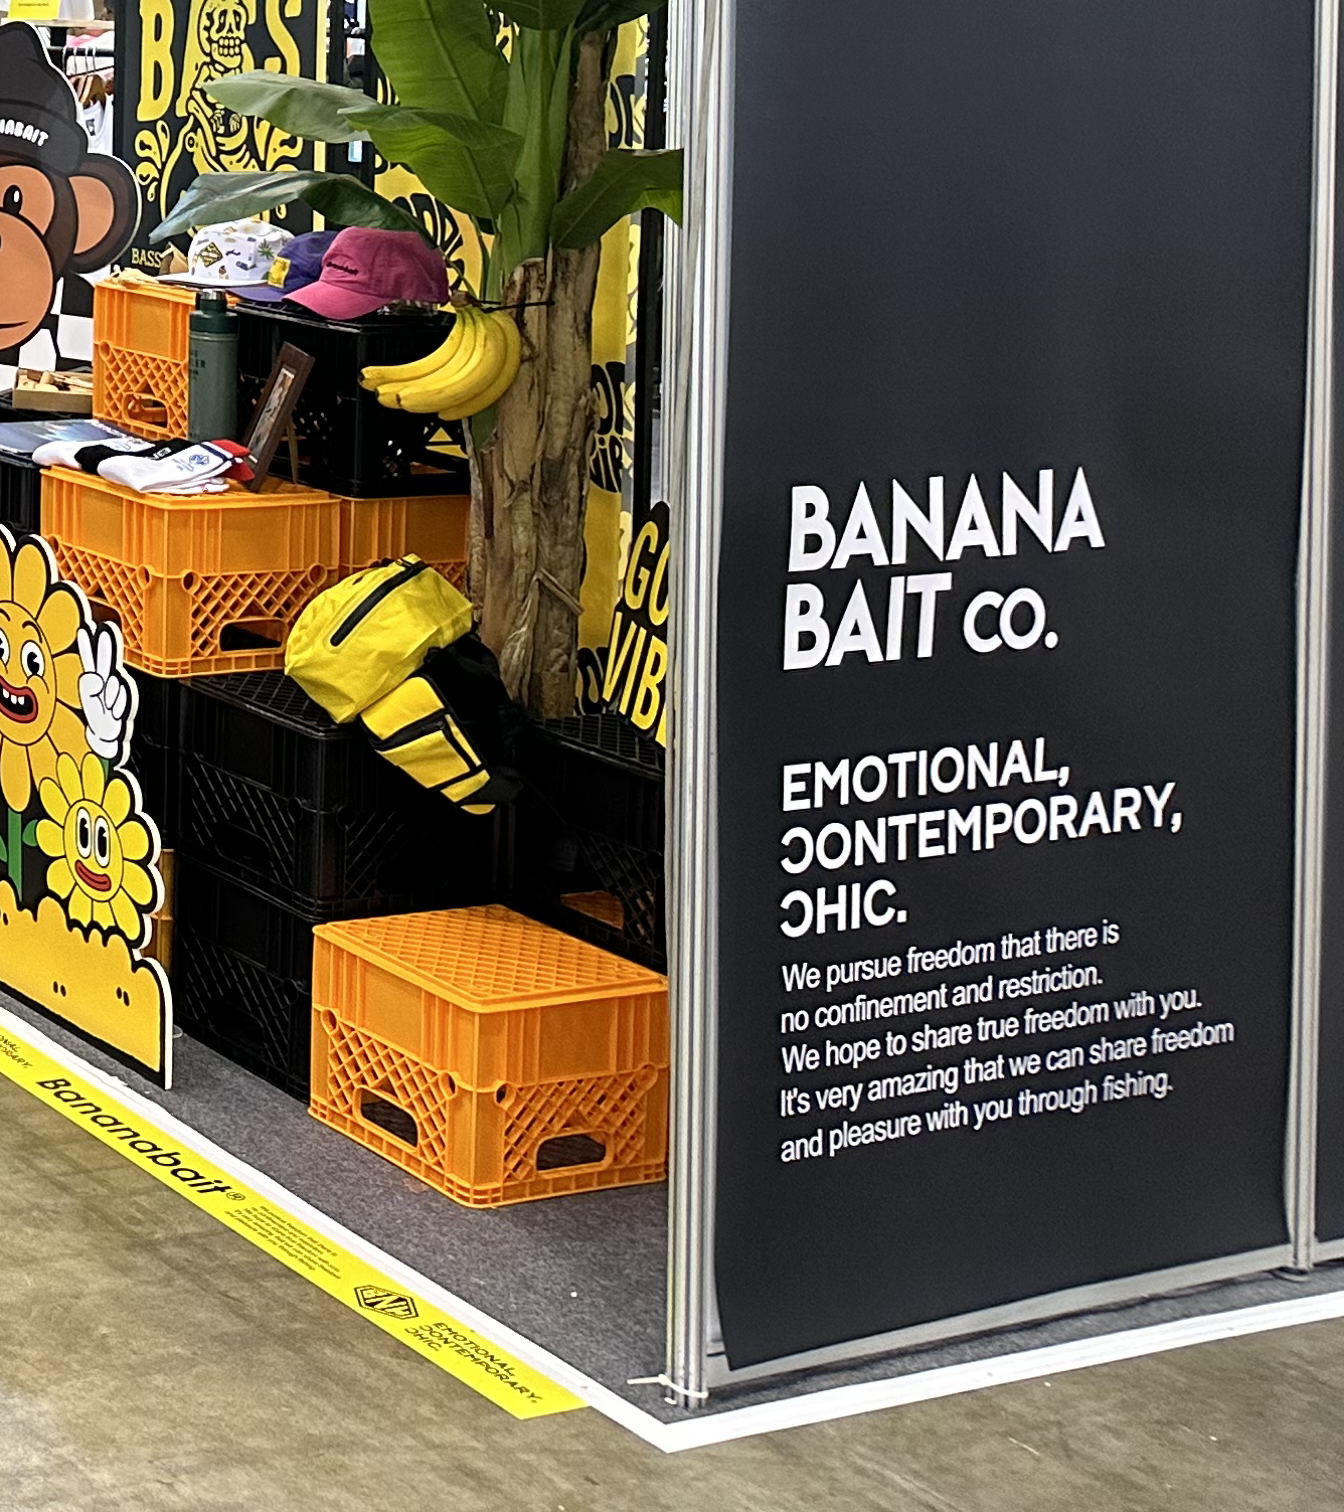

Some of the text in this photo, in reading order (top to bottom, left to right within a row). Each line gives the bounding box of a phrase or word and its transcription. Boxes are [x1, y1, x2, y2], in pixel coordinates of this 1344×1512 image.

[787, 466, 1106, 573] BANANA
[782, 572, 1060, 672] BAIT CO.
[782, 736, 1070, 812] EMOTIONAL,
[780, 964, 1103, 1033] no confinement and restriction.
[782, 920, 1120, 992] We pursue freedom that there is
[780, 1019, 1234, 1116] It's very amazing that we can share freedom
[782, 988, 1202, 1073] We hope to share true freedom with you.
[780, 1070, 1172, 1162] and pleasure with you through fishing.
